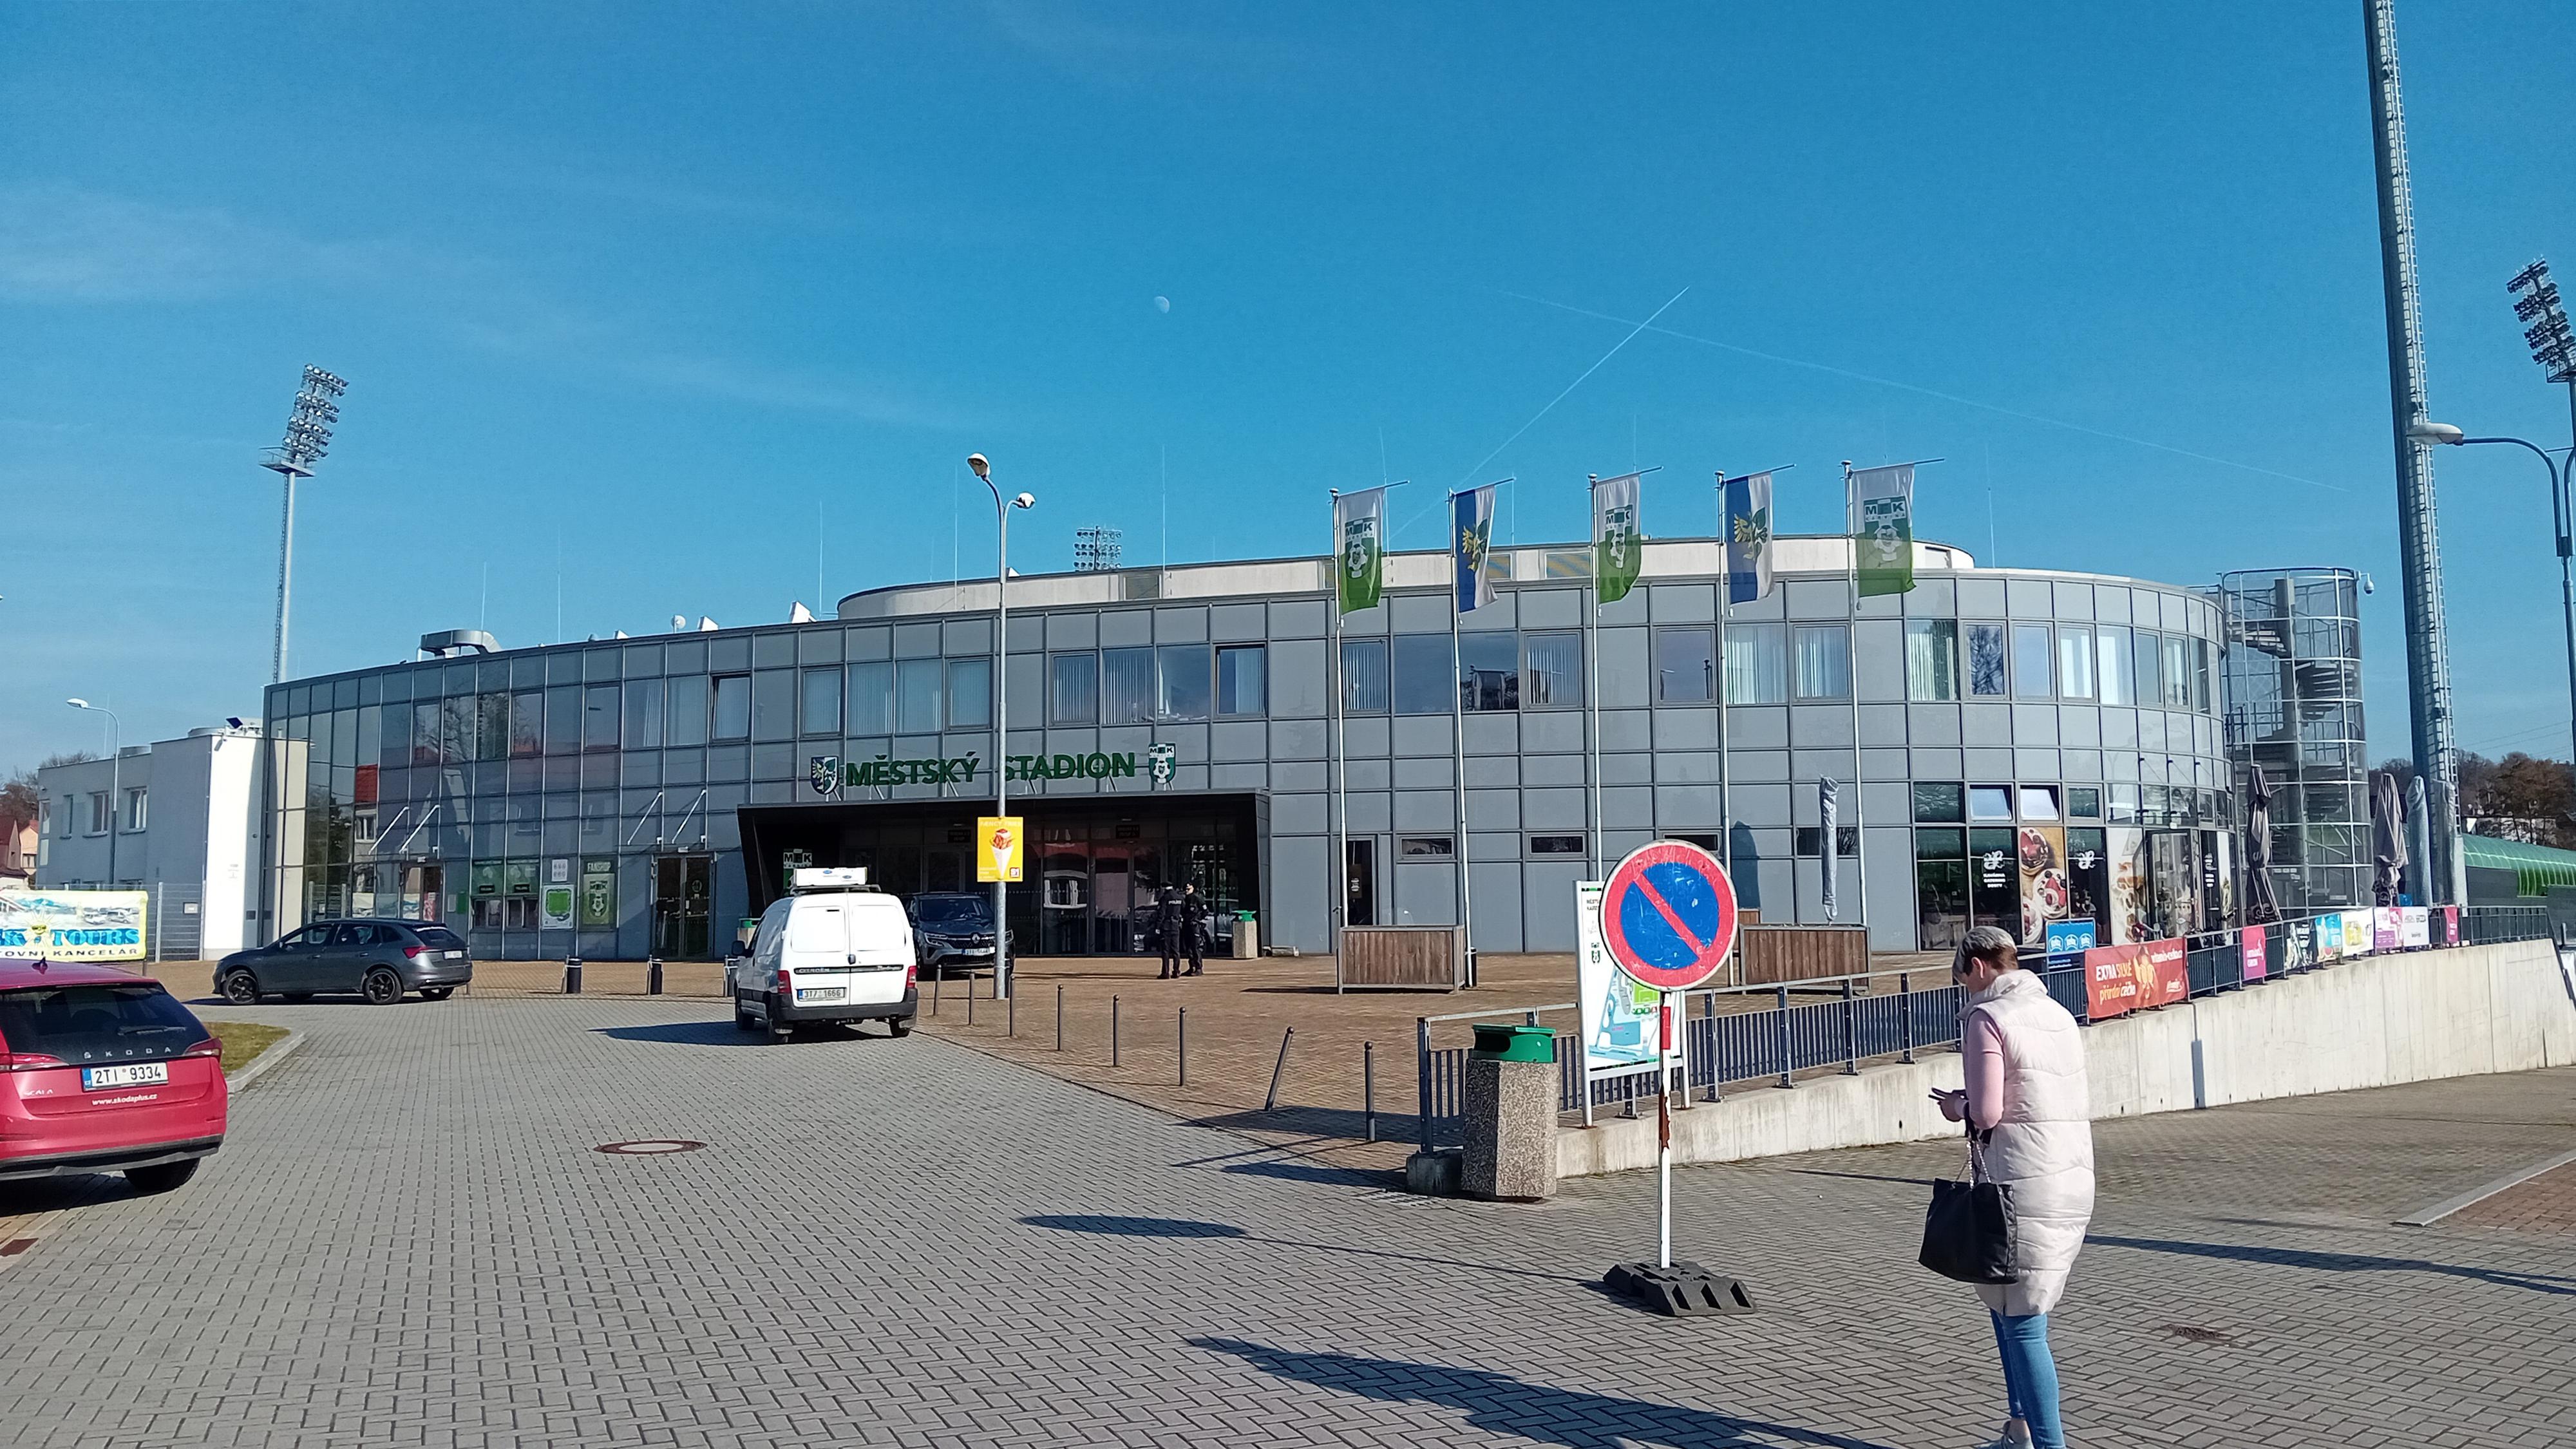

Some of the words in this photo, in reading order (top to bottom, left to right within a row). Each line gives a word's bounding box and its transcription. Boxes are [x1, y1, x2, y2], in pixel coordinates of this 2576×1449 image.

[846, 751, 981, 786] MĚSTSKÝ
[1005, 752, 1135, 781] STADION
[50, 928, 140, 945] TOURS
[2096, 964, 2117, 982] EXTRA
[95, 1068, 118, 1084] 2TI
[129, 1066, 162, 1080] 9334
[92, 1093, 158, 1106] www.skodaplus.cz
